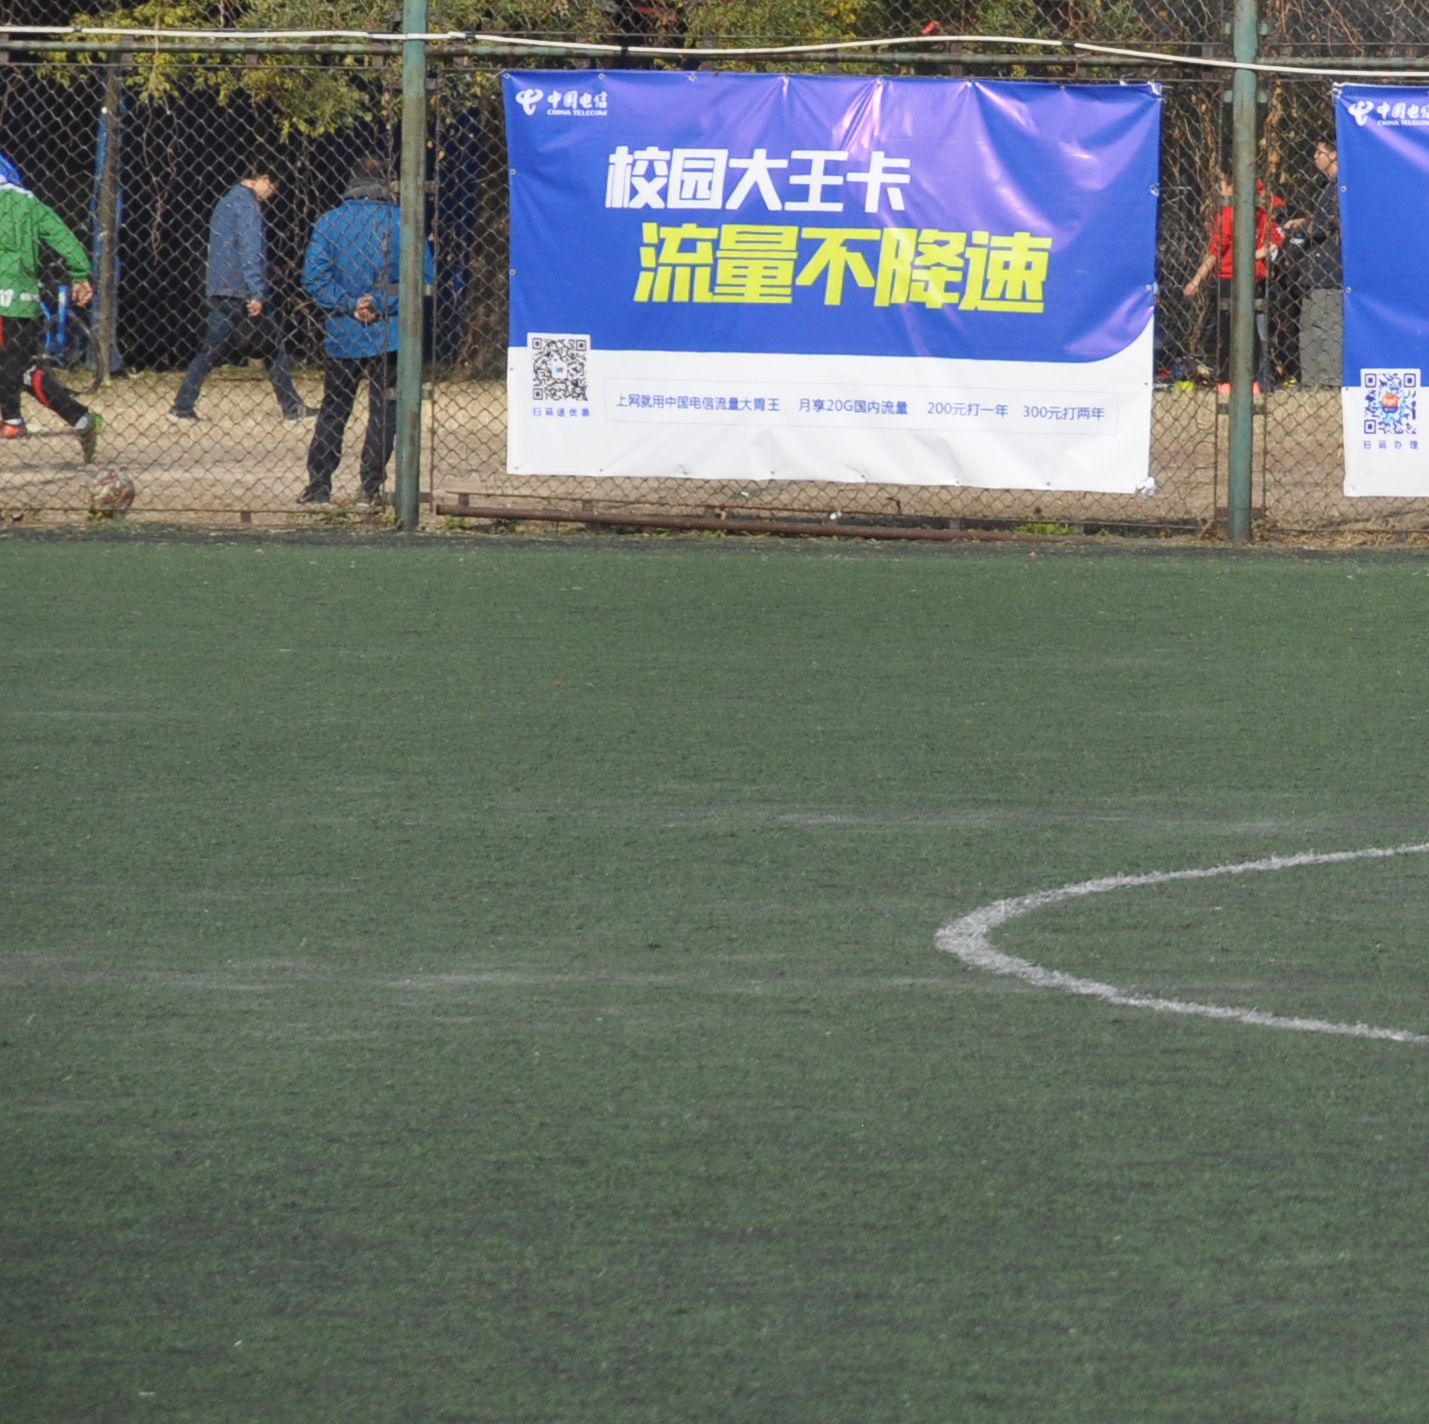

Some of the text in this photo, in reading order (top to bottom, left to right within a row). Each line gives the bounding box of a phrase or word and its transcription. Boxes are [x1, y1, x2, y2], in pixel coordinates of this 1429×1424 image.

[546, 90, 608, 109] 中国电信
[605, 146, 912, 213] 校园大王卡
[633, 221, 1053, 314] 流量不降速
[798, 398, 909, 416] 月享20G国内流量
[927, 401, 1009, 418] 200元打一年
[1022, 405, 1106, 421] 300元打两年
